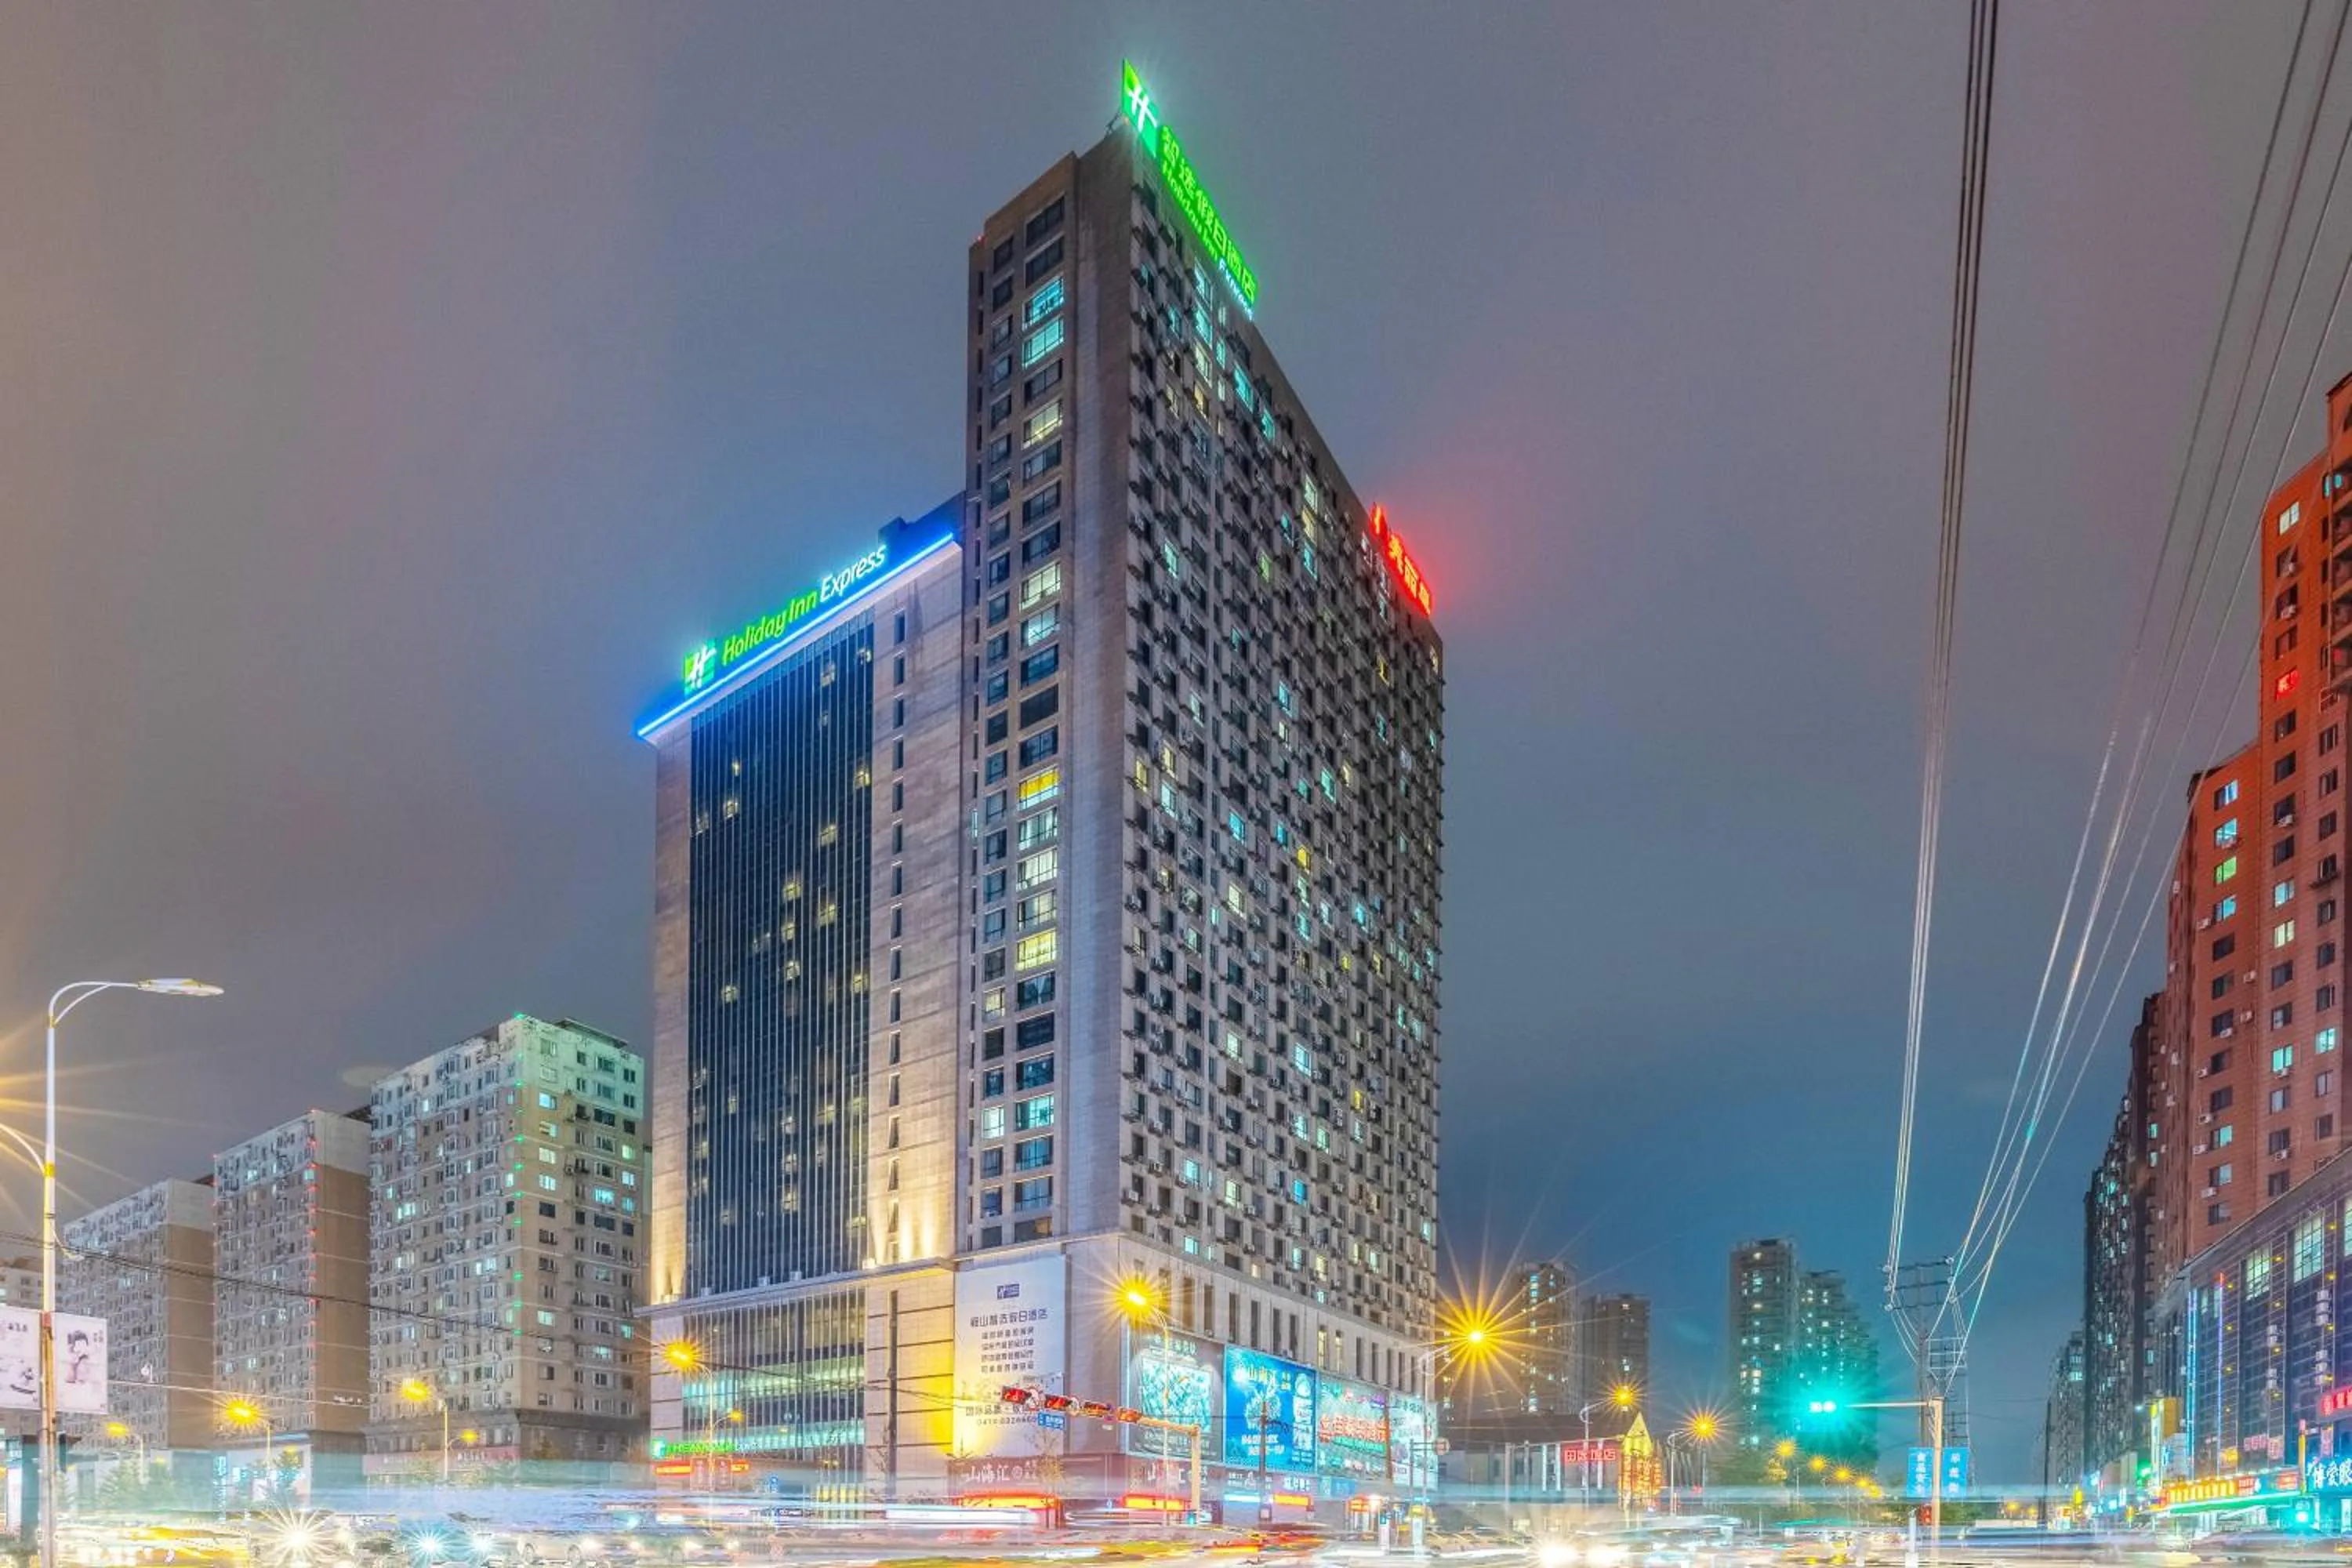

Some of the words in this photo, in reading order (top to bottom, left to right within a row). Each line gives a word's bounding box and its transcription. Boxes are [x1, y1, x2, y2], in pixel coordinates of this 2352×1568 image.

[723, 611, 787, 664] Holiday
[788, 590, 817, 622] Inn
[820, 544, 887, 601] Express
